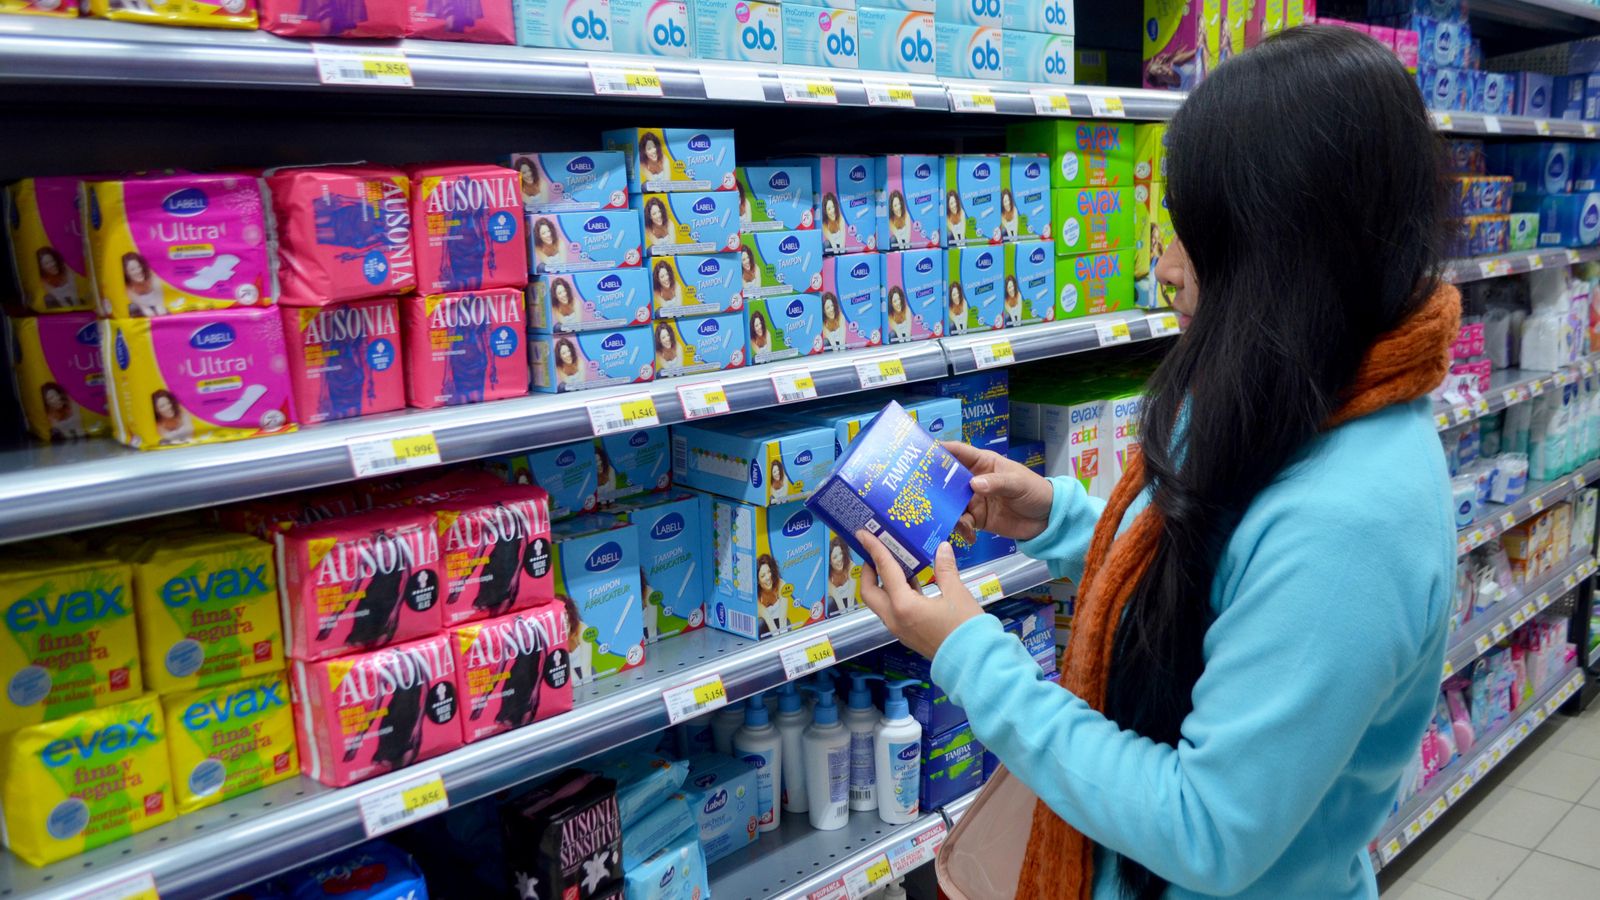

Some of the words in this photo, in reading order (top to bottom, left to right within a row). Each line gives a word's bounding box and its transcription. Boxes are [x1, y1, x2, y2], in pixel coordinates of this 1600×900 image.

[1045, 0, 1067, 25] o.b.
[572, 9, 609, 41] o.b.
[654, 17, 687, 48] o.b.
[742, 19, 777, 51] o.b.
[827, 27, 856, 56] o.b.
[901, 29, 934, 63] o.b.
[972, 39, 1001, 71] o.b.
[1045, 50, 1066, 75] o.b.
[1076, 125, 1120, 151] evax
[571, 163, 592, 171] LABELL
[688, 155, 714, 166] TAMPON
[566, 174, 596, 185] TAMPON
[169, 199, 206, 210] LABELL
[427, 177, 520, 212] AUSONIA
[768, 192, 792, 205] TAMPON
[1077, 190, 1121, 215] evax
[696, 203, 713, 211] LABELL
[158, 222, 219, 242] Ultra
[587, 222, 608, 230] LABELL
[692, 217, 718, 228] TAMPON
[383, 183, 414, 286] AUSONIA
[583, 234, 612, 245] TAMPON
[778, 256, 802, 268] TAMPON
[1074, 254, 1121, 282] evax
[600, 281, 621, 289] LABELL
[698, 278, 722, 290] TAMPON
[597, 291, 624, 304] TAMPON
[431, 294, 520, 329] AUSONIA
[304, 304, 397, 344] AUSONIA
[701, 324, 717, 332] LABELL
[786, 320, 806, 332] TAMPON
[197, 333, 233, 345] LABELL
[604, 339, 624, 348] LABELL
[698, 337, 721, 348] TAMPON
[601, 349, 628, 362] TAMPON
[186, 357, 247, 377] Ultra
[961, 402, 995, 419] AMPAX
[1071, 405, 1099, 424] evax
[1071, 424, 1098, 446] adapt
[882, 442, 923, 492] TAMPAX
[446, 499, 551, 551] AUSONIA
[655, 522, 682, 536] LABELL
[787, 519, 810, 533] LABELL
[316, 524, 440, 586] AUSONIA
[590, 553, 619, 567] LABELL
[654, 546, 682, 562] TAMPON
[785, 542, 813, 558] TAMPON
[163, 563, 268, 608] evax
[588, 578, 620, 597] TAMPON
[6, 585, 126, 632] evax
[192, 608, 232, 627] fina
[38, 632, 84, 652] fina
[185, 620, 253, 644] segura
[467, 610, 569, 669] AUSONIA
[1023, 630, 1052, 648] TAMPAX
[32, 645, 108, 672] segura
[812, 651, 831, 662] 3,15€
[338, 638, 455, 707] AUSONIA
[705, 689, 724, 701] 3,15€
[183, 681, 283, 731] evax
[42, 713, 156, 768] evax
[208, 736, 272, 760] segura
[212, 728, 250, 748] fina
[945, 743, 971, 761] TAMPAX
[75, 764, 118, 786] fina
[69, 774, 143, 800] segura
[705, 795, 727, 812] Labell
[561, 795, 619, 849] AUSONIA
[560, 818, 621, 869] SENSITIVE
